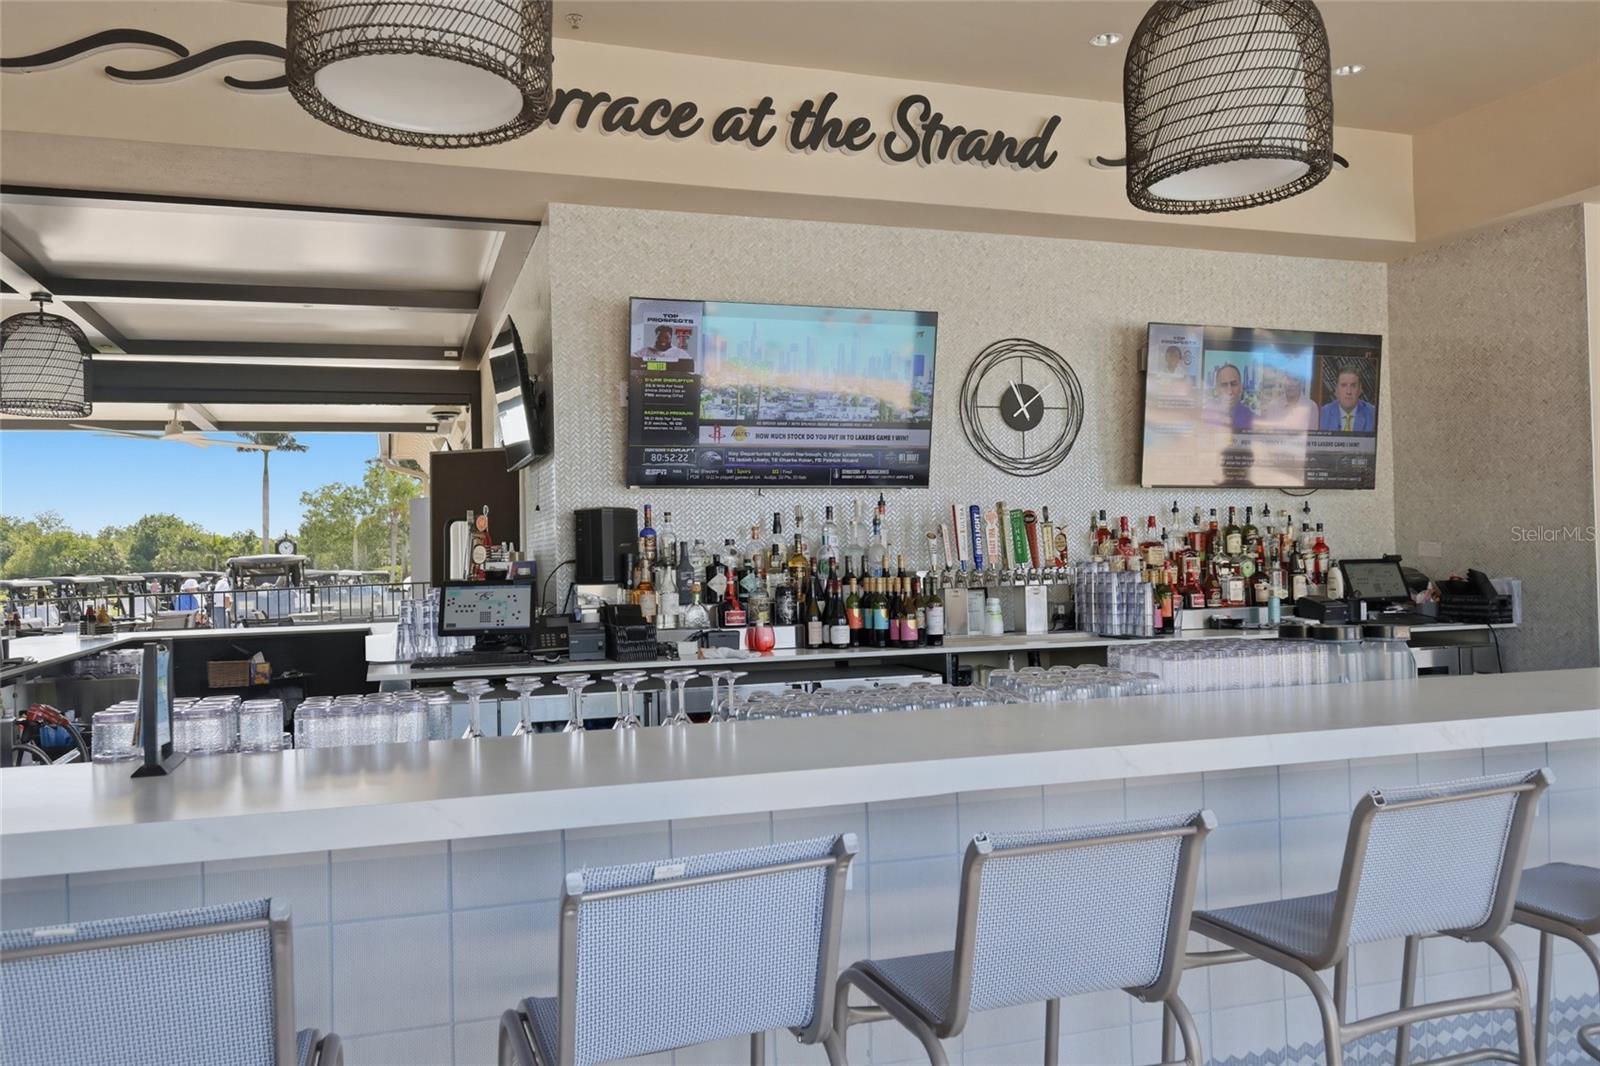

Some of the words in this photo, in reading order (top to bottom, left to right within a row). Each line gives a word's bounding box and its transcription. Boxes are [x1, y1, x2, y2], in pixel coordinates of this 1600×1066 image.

[548, 88, 704, 138] rrace
[712, 96, 777, 147] at
[790, 91, 877, 151] the
[884, 94, 1061, 169] Strand
[651, 453, 689, 462] 80:52:22
